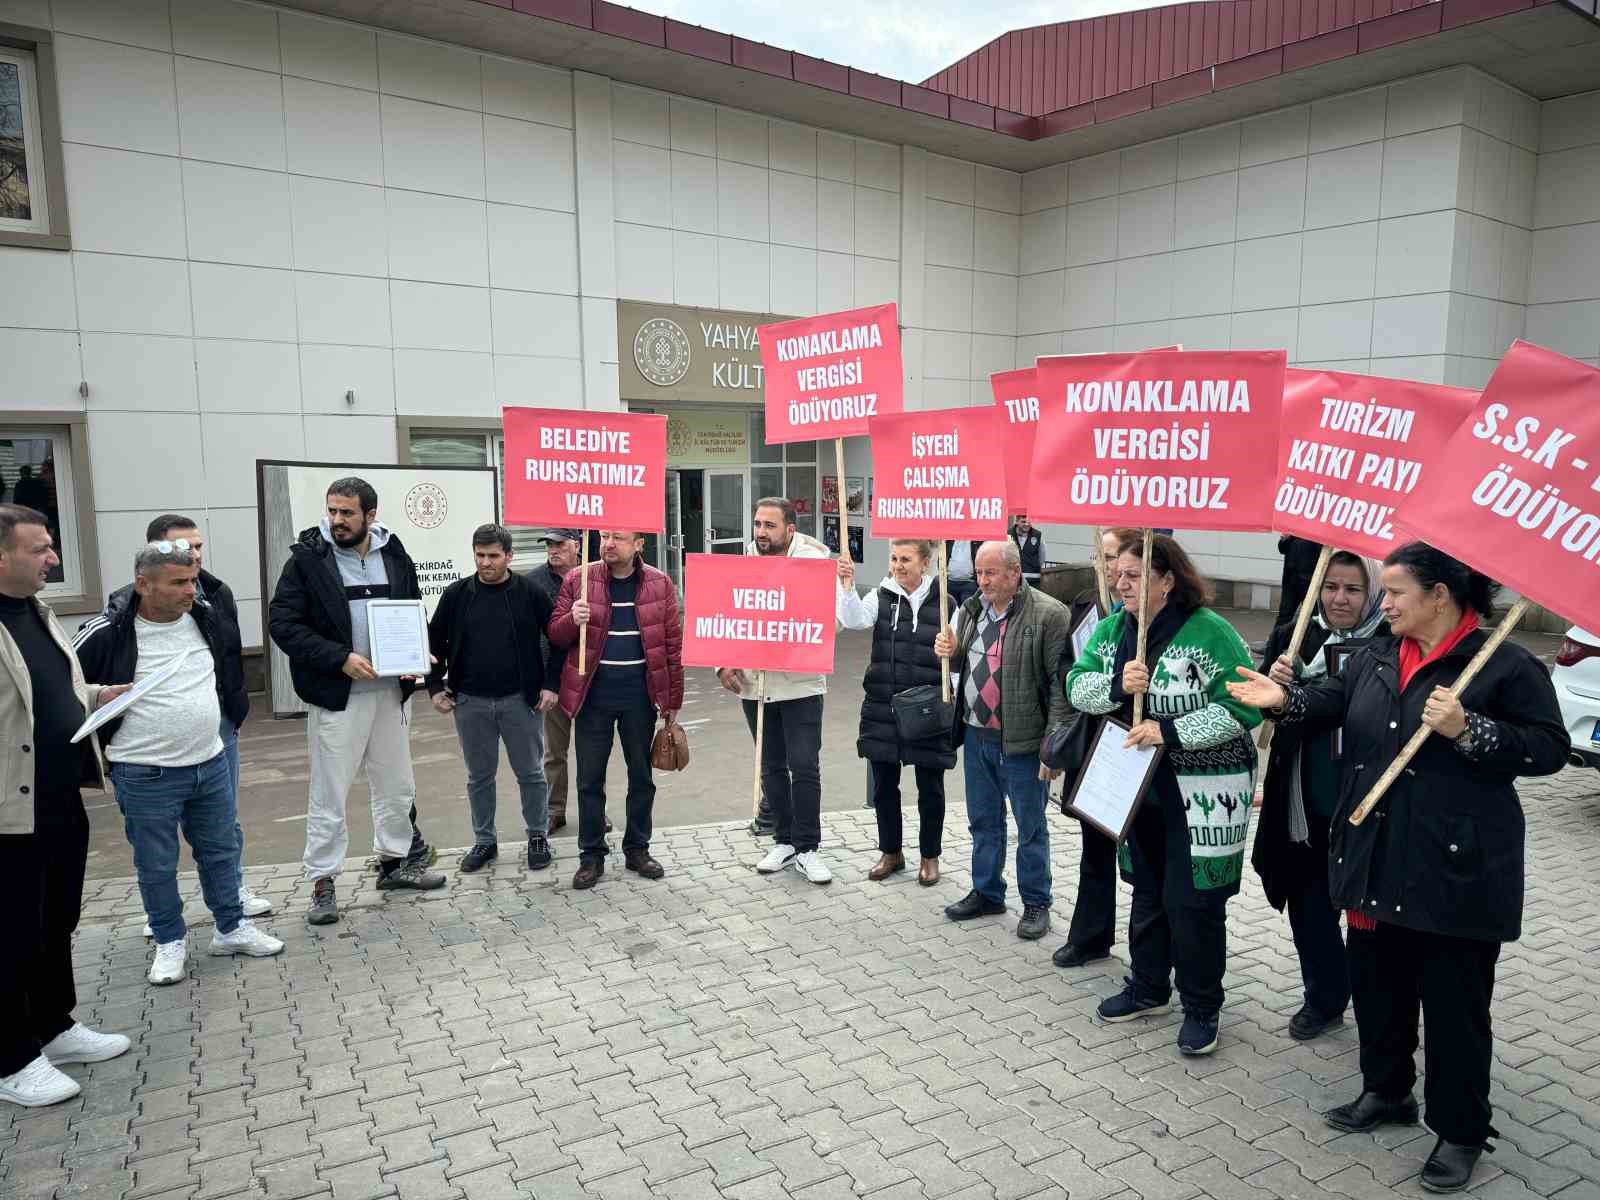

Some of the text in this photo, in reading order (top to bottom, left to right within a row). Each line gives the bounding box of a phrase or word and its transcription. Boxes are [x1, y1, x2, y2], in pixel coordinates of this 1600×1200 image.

[700, 322, 760, 350] YAHYA
[776, 324, 883, 362] KONAKLAMA
[712, 356, 765, 389] KÜLT
[797, 356, 863, 392] VERGİSİ
[788, 394, 878, 426] ÖDÜYORUZ
[1004, 397, 1040, 424] TUR
[1065, 380, 1251, 413] KONAKLAMA
[1319, 398, 1416, 443] TURİZM
[1472, 403, 1577, 470] S.S.K
[540, 425, 631, 454] BELEDİYE
[912, 430, 959, 459] İŞYERİ
[1093, 421, 1210, 461] VERGİSİ
[525, 458, 646, 487] RUHSATIMIZ
[1287, 439, 1356, 481] KATKI
[1356, 453, 1423, 494] PAYI
[903, 465, 970, 491] ÇALIŞMA
[1070, 467, 1231, 510] ÖDÜYORUZ
[565, 493, 604, 517] VAR
[877, 497, 1003, 520] RUHSATIMIZ VAR
[732, 585, 786, 612] VERGİ
[695, 613, 824, 645] MÜKELLEFİYİZ
